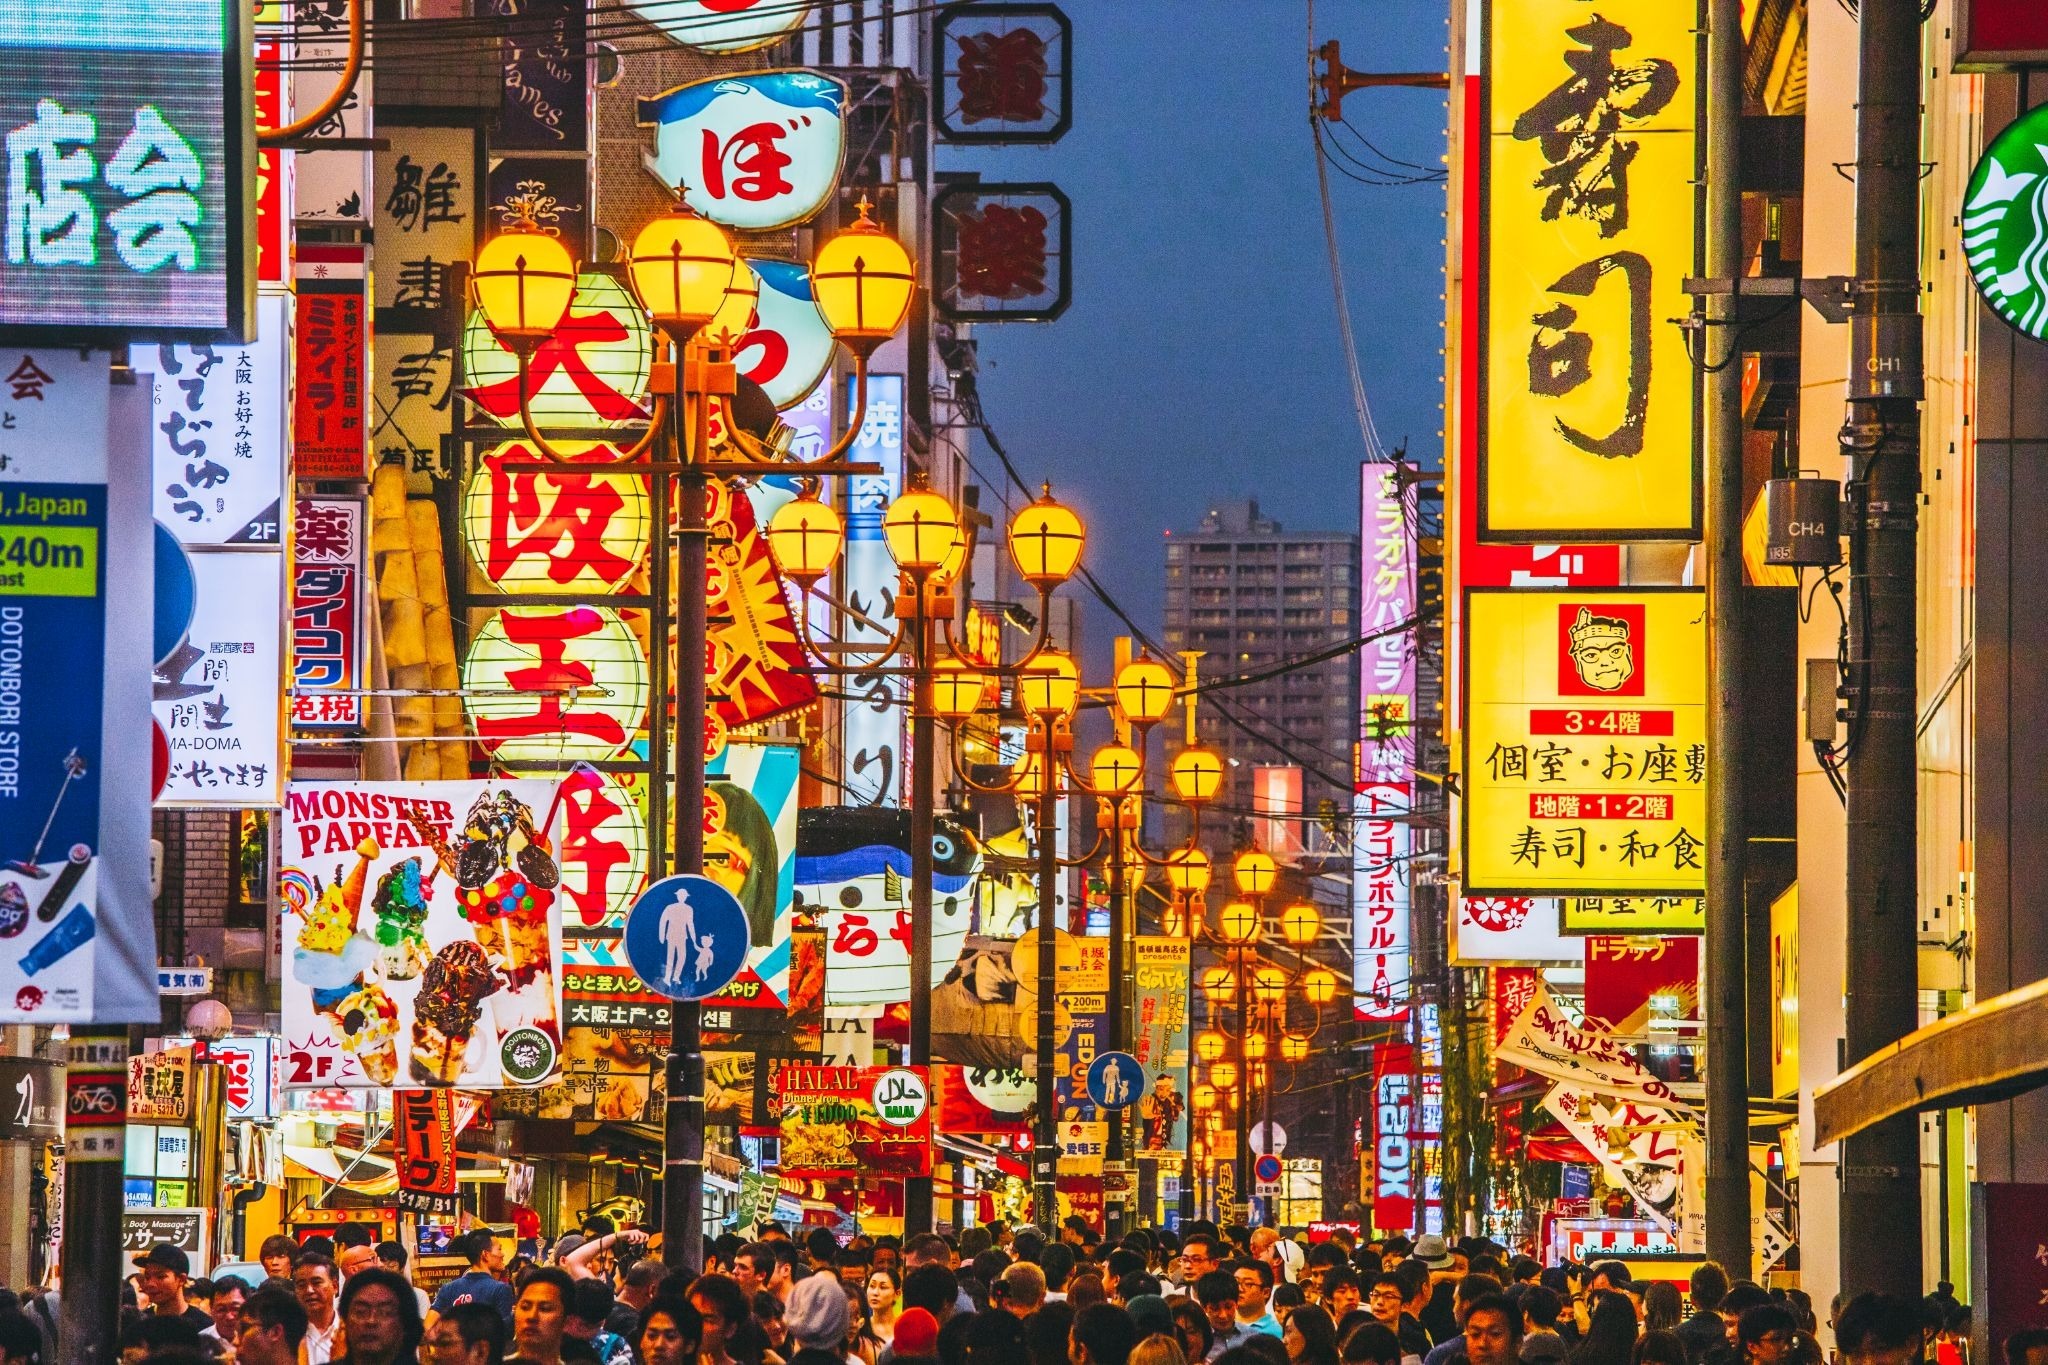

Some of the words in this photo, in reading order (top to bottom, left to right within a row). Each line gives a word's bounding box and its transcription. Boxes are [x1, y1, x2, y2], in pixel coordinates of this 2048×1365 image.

[702, 115, 812, 201] ぼ
[5, 354, 55, 401] 会
[235, 351, 254, 384] 大阪
[1866, 357, 1901, 372] CH1
[234, 390, 254, 459] お好み焼
[16, 493, 87, 520] Japan
[249, 522, 277, 541] 2F
[1788, 522, 1825, 537] CH4
[294, 567, 345, 687] ダイコク
[1, 606, 23, 724] DOTONBORI
[0, 730, 18, 798] STORE
[285, 790, 455, 823] MONSTER
[1073, 996, 1101, 1006] 200m
[504, 1032, 549, 1052] DOUTONBORI
[283, 1051, 333, 1083] 2F
[787, 1069, 860, 1091] HALAL
[783, 1091, 817, 1104] Dinner
[878, 1077, 923, 1105] حلال
[885, 1105, 916, 1119] HALAL
[128, 1220, 149, 1229] Body
[151, 1220, 185, 1229] Massage
